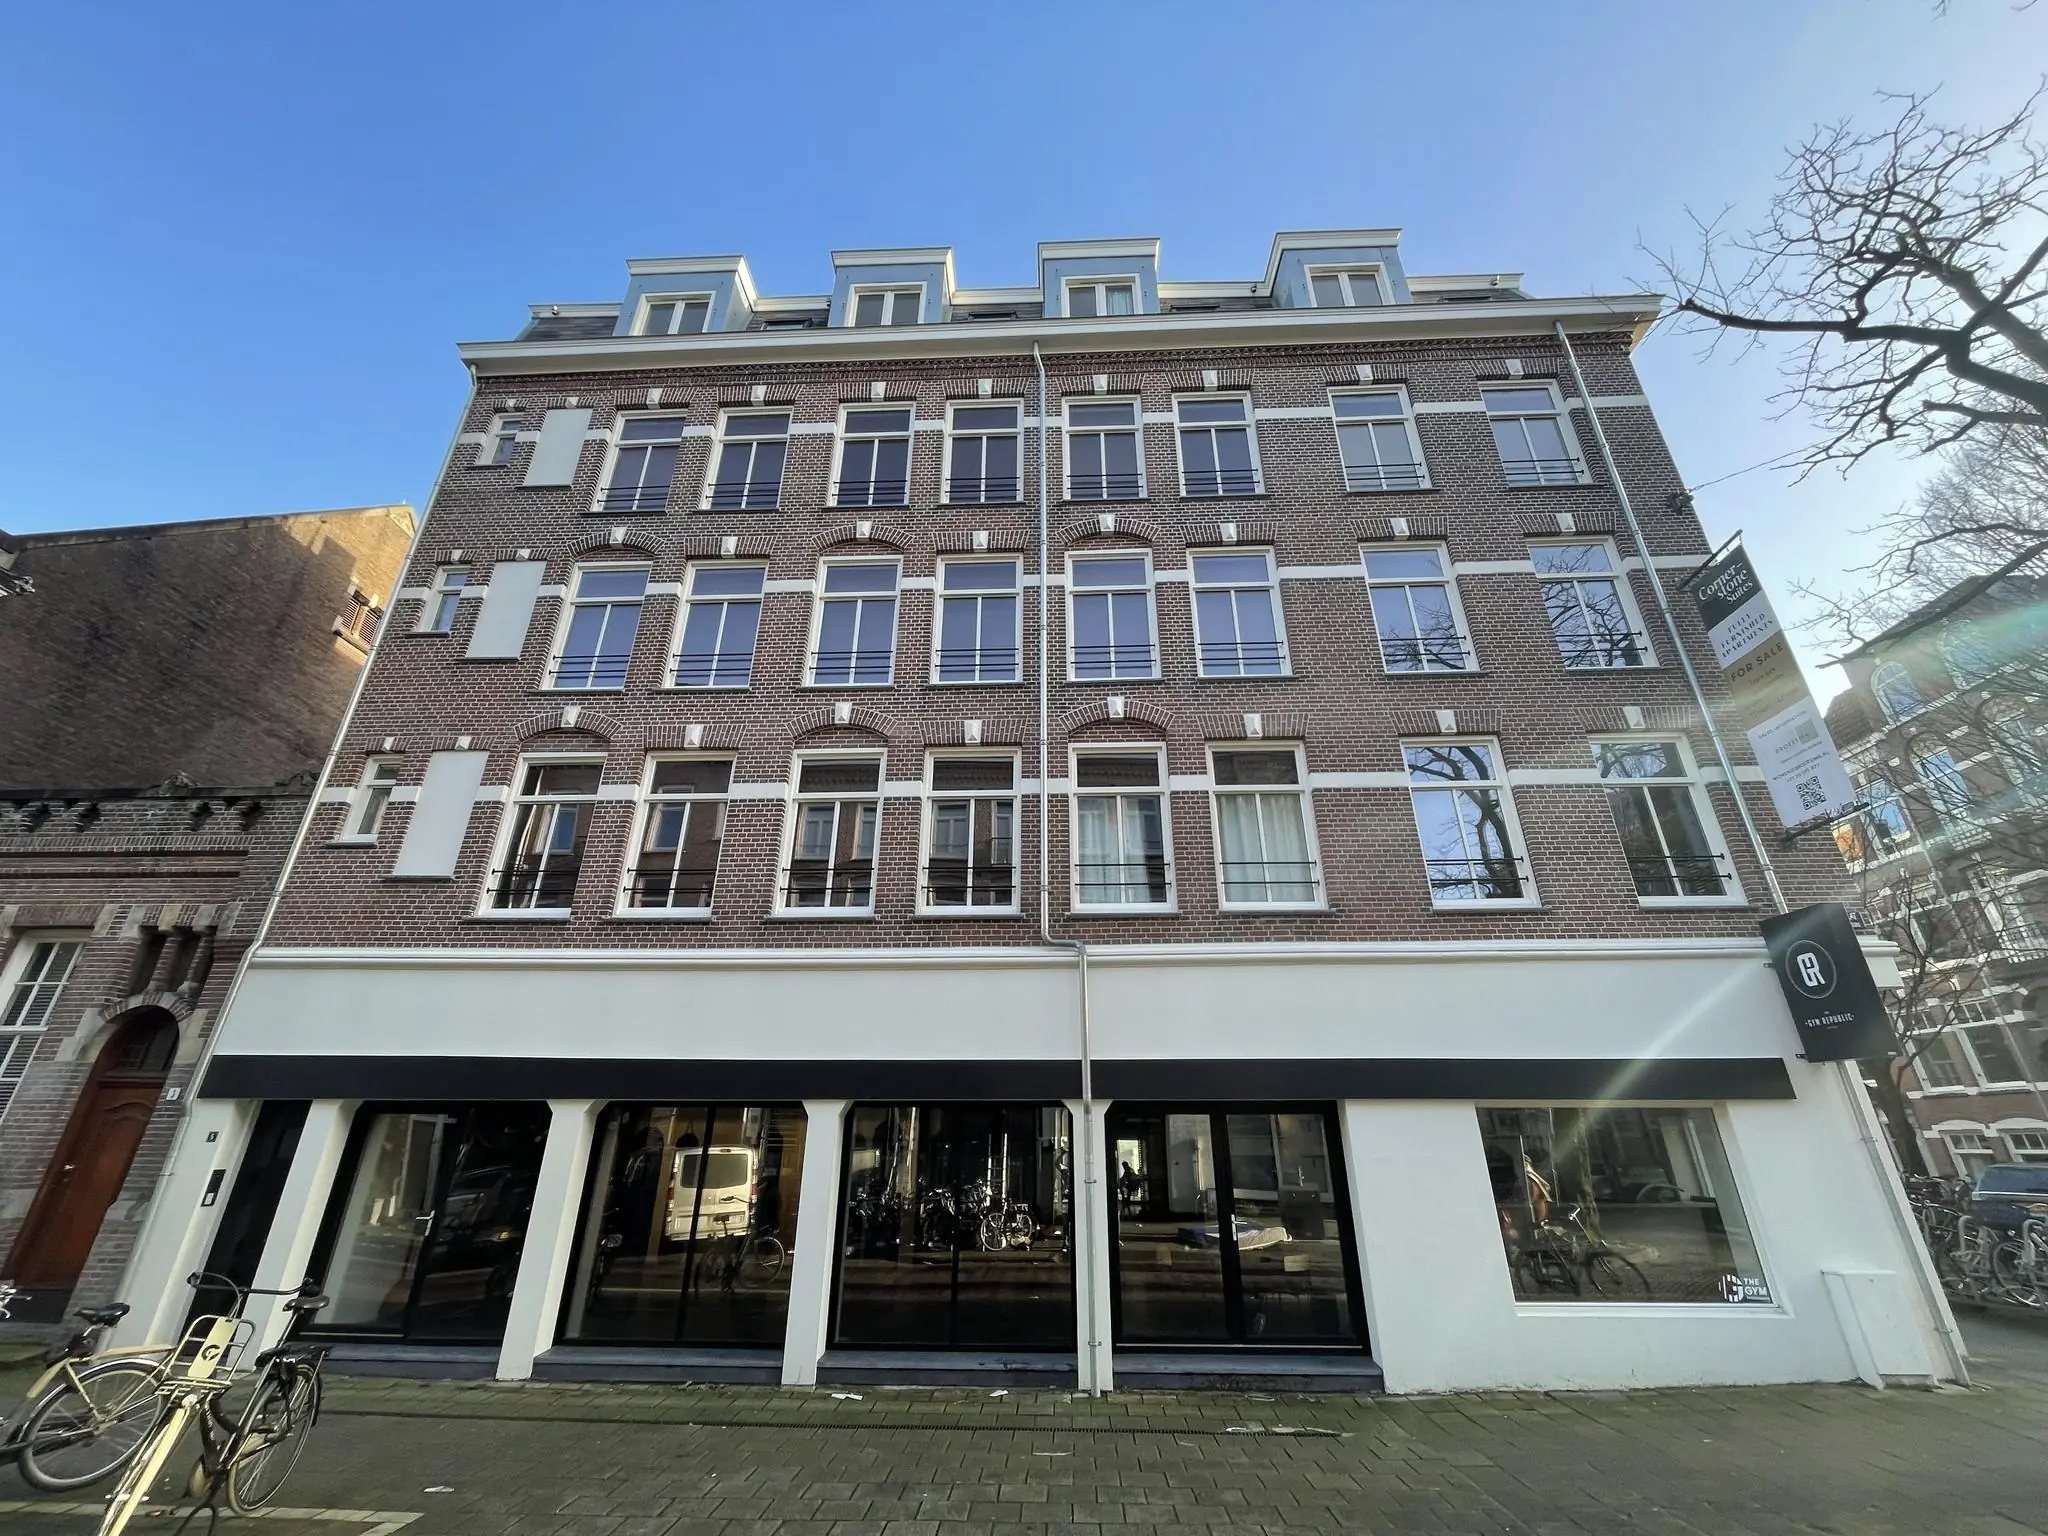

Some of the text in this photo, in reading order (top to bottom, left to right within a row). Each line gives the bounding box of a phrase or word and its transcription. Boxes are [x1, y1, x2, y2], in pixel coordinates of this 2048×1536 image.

[1717, 570, 1748, 599] stone
[1727, 581, 1752, 604] Suites
[1721, 613, 1765, 648] FURNISHED
[1727, 612, 1752, 633] FULLY
[1722, 620, 1773, 657] APARTMENTS
[1731, 663, 1753, 682] FOR
[1756, 642, 1784, 665] SALE
[1807, 1013, 1852, 1027] GYM REPUBLIC
[1743, 1277, 1760, 1285] THE
[1744, 1286, 1768, 1296] GYM
